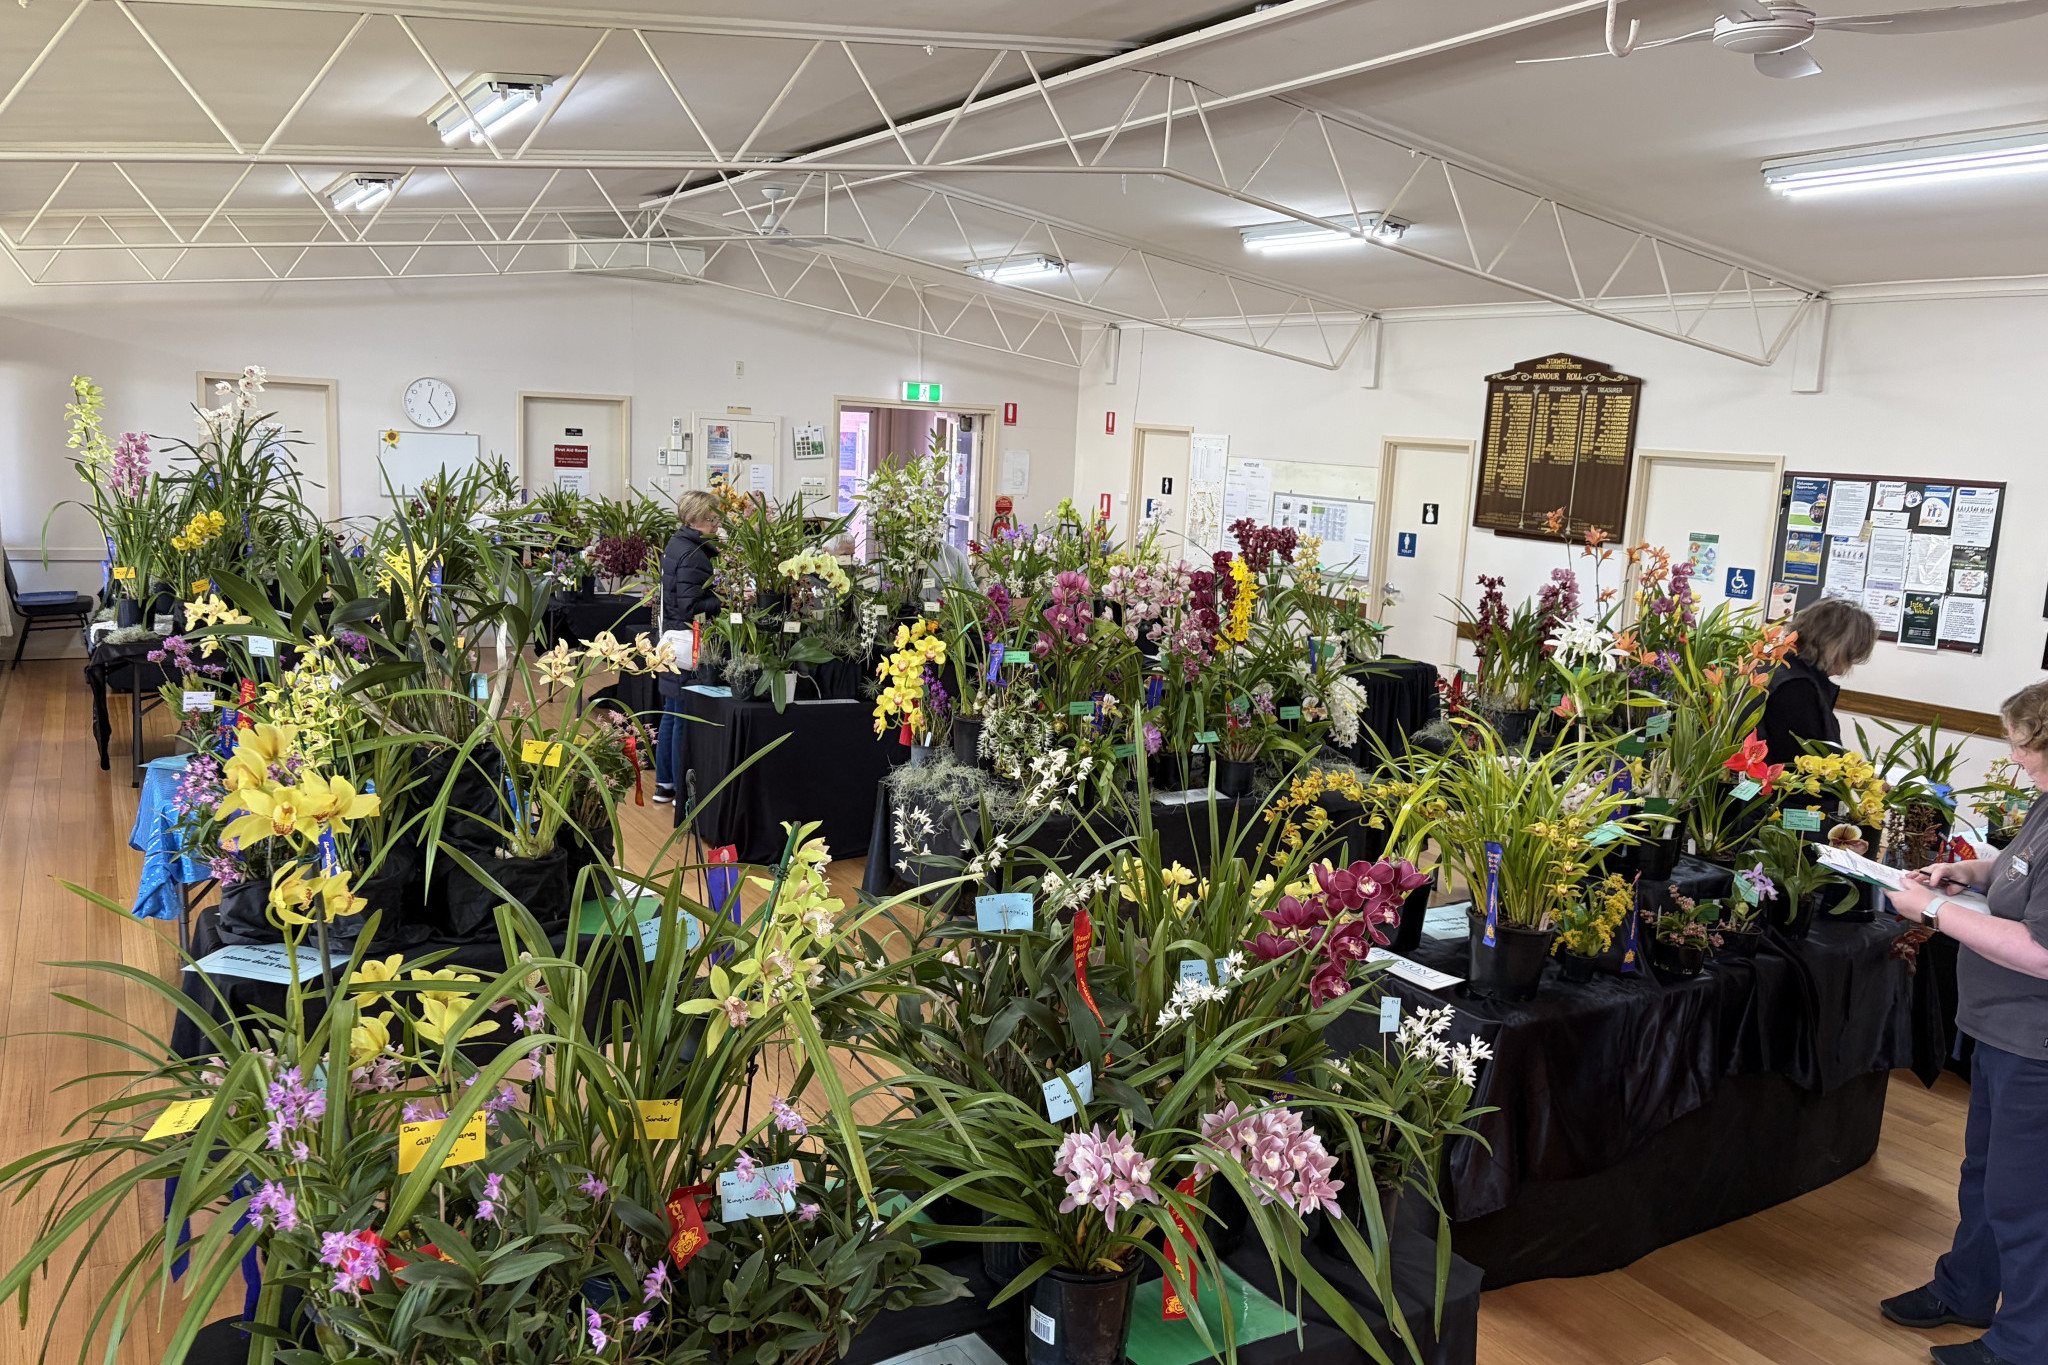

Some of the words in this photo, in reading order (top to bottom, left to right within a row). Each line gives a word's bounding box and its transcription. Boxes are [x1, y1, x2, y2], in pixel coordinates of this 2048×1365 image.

[1532, 372, 1560, 380] HONOUR
[1566, 372, 1582, 381] ROLL
[1909, 600, 1924, 609] Into
[1914, 606, 1934, 616] Woods
[244, 945, 269, 953] Enjoy
[251, 959, 275, 967] don't
[645, 1114, 672, 1122] Sander
[403, 1125, 420, 1133] Den
